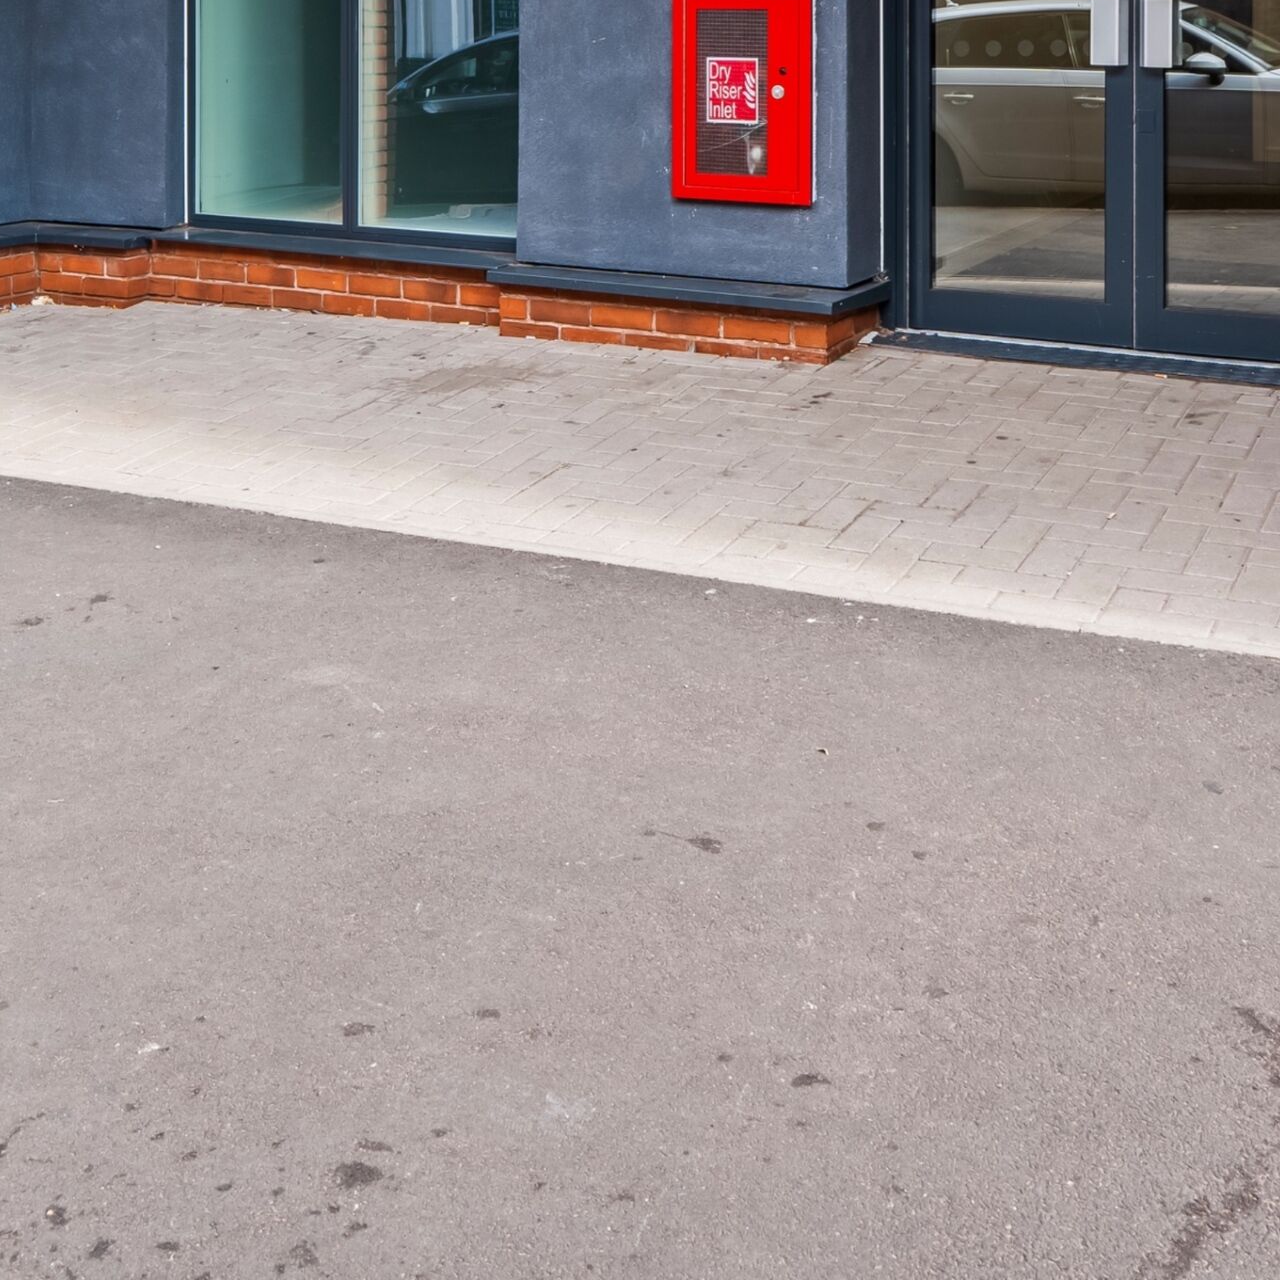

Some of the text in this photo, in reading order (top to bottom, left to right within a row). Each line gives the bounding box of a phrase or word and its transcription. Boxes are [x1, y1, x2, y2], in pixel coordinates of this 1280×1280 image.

[709, 61, 732, 84] Dry
[709, 80, 743, 100] Riser
[709, 100, 737, 119] Inlet
